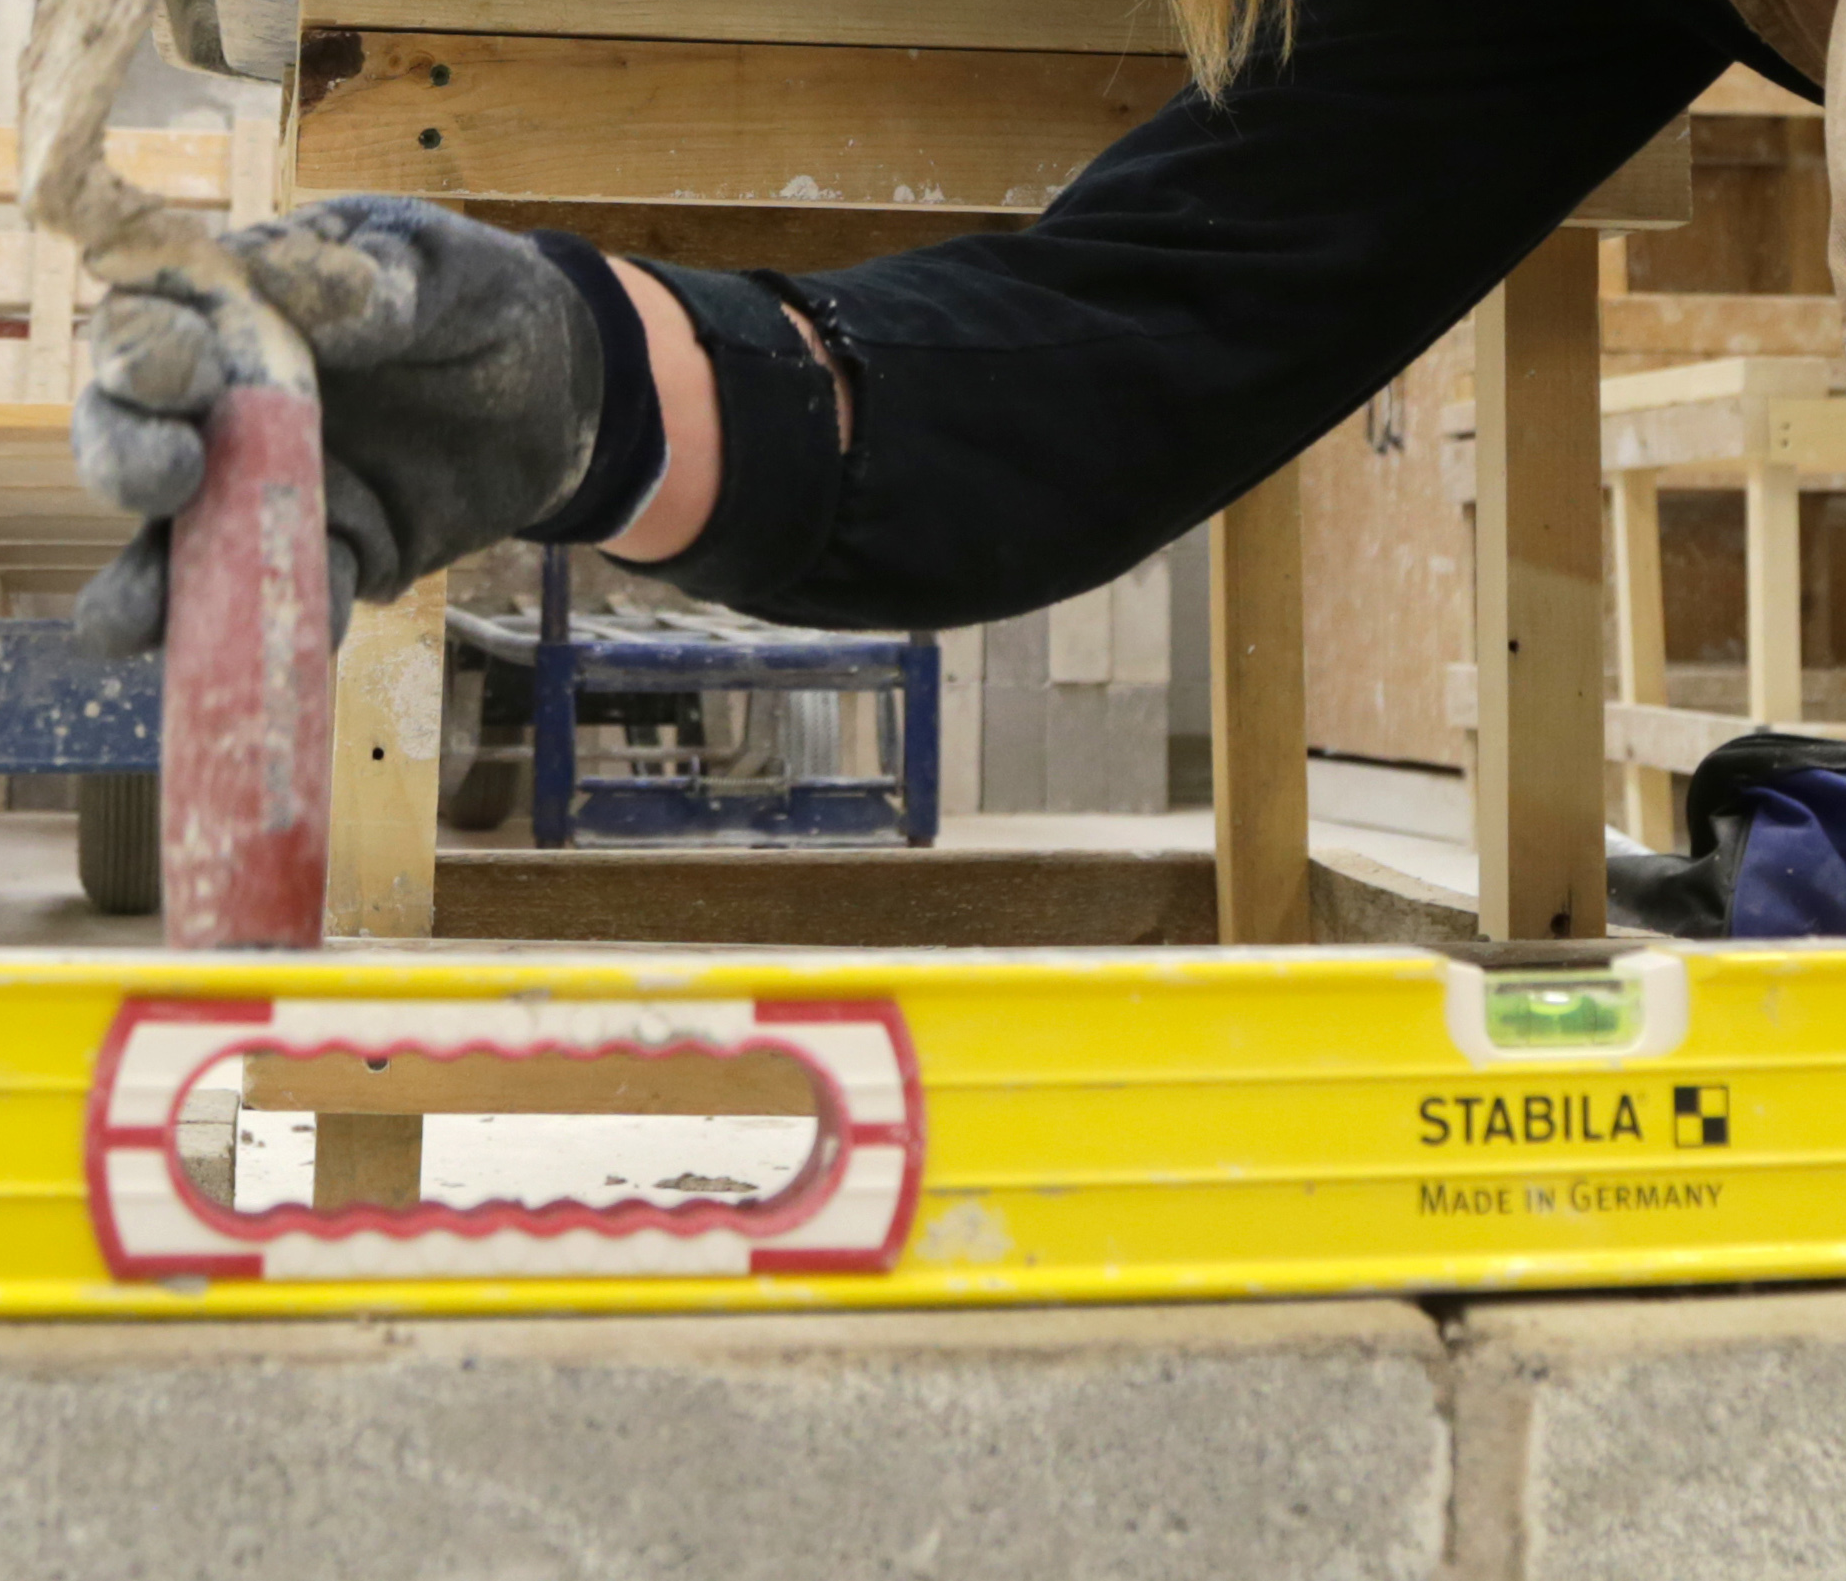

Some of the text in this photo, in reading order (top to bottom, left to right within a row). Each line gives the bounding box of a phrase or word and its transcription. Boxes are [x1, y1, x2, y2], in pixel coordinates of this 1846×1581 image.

[1418, 1094, 1643, 1146] STABILA
[1418, 1183, 1514, 1216] MADE
[1570, 1180, 1724, 1213] GERMANY
